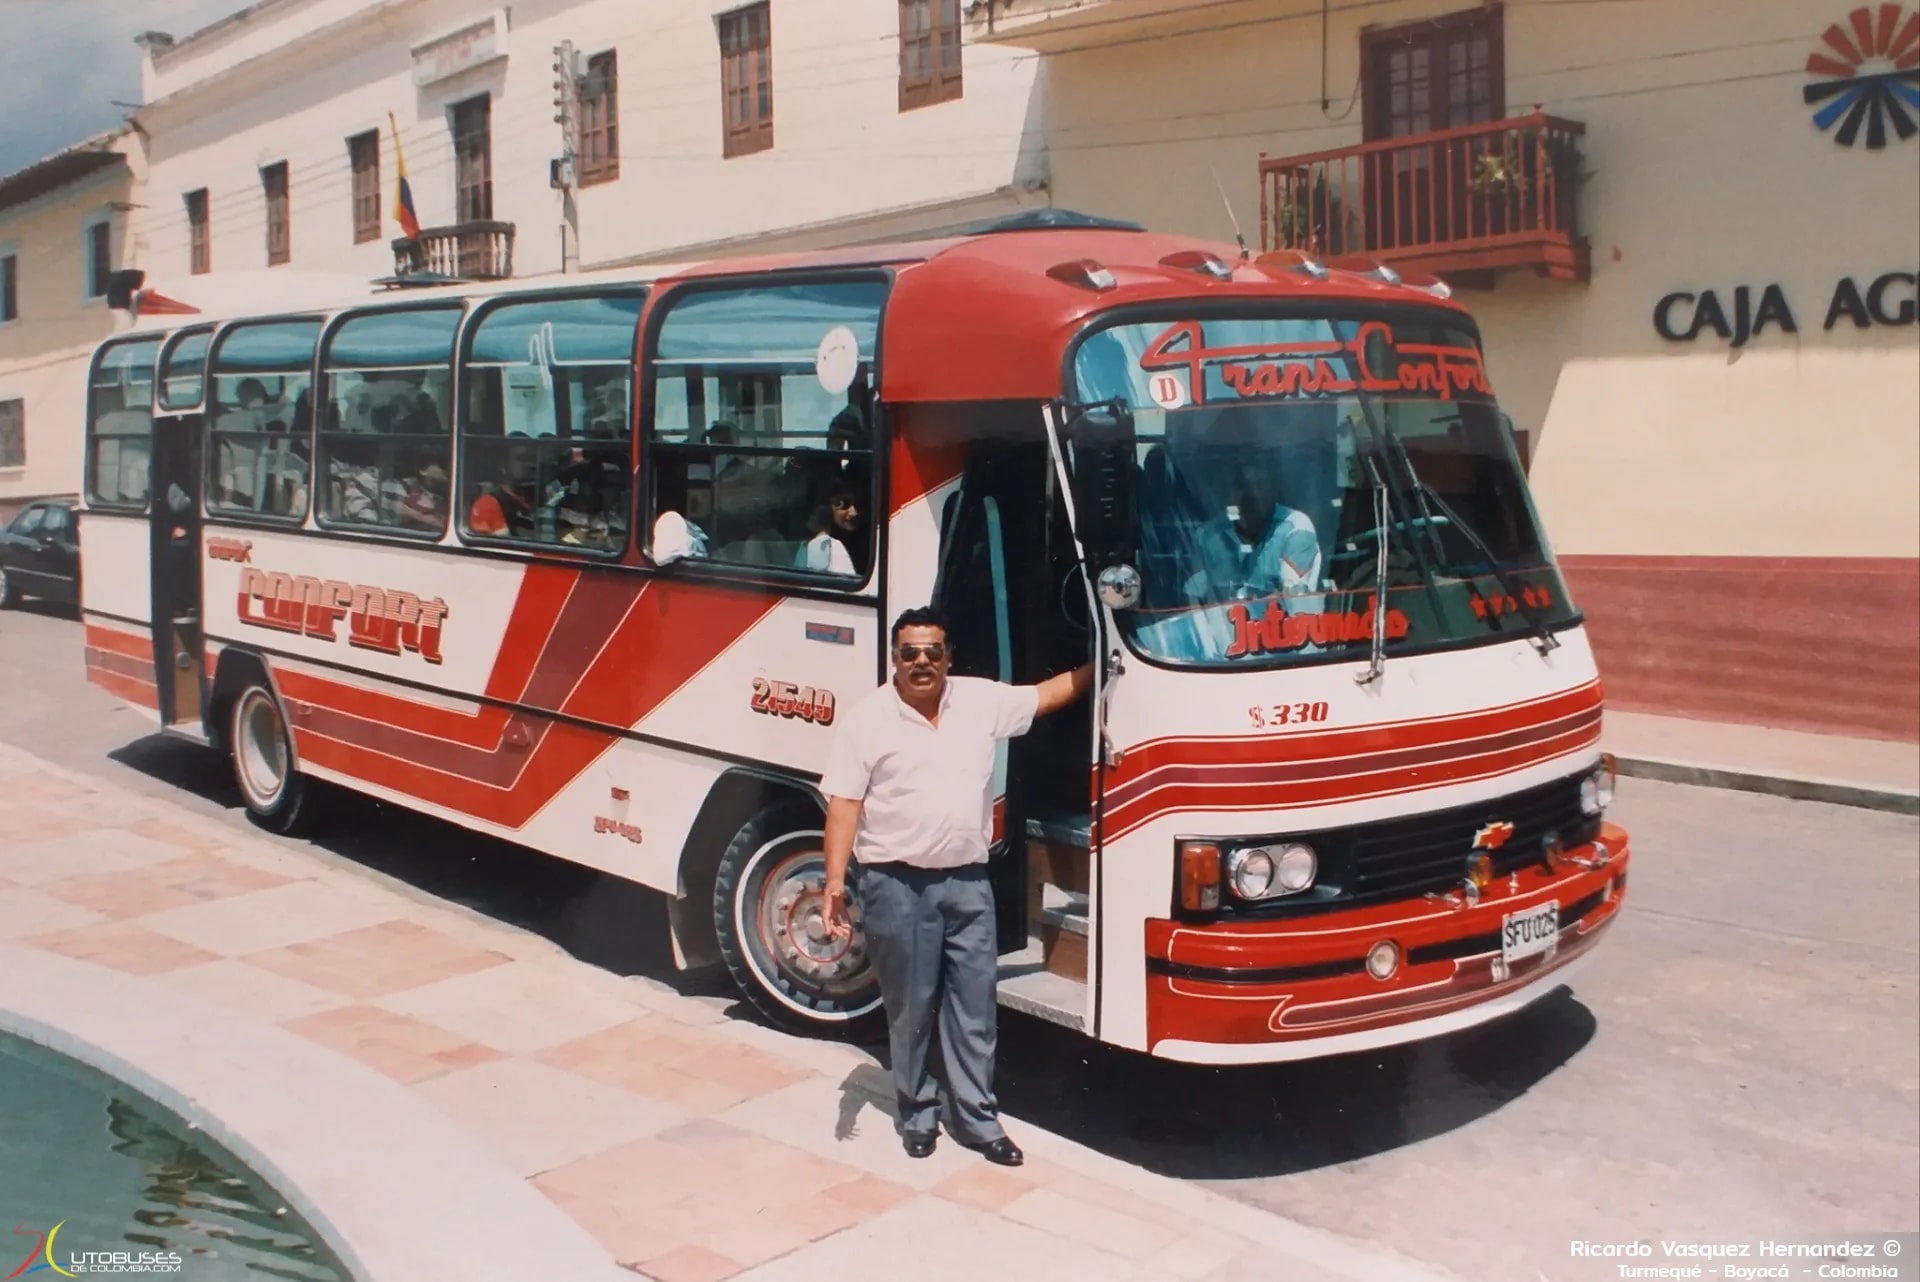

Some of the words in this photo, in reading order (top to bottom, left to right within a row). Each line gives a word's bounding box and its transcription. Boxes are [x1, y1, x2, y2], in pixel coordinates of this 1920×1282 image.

[1653, 284, 1798, 348] CAJA
[1823, 272, 1920, 330] AG
[1160, 377, 1177, 403] D
[751, 677, 836, 727] 21549
